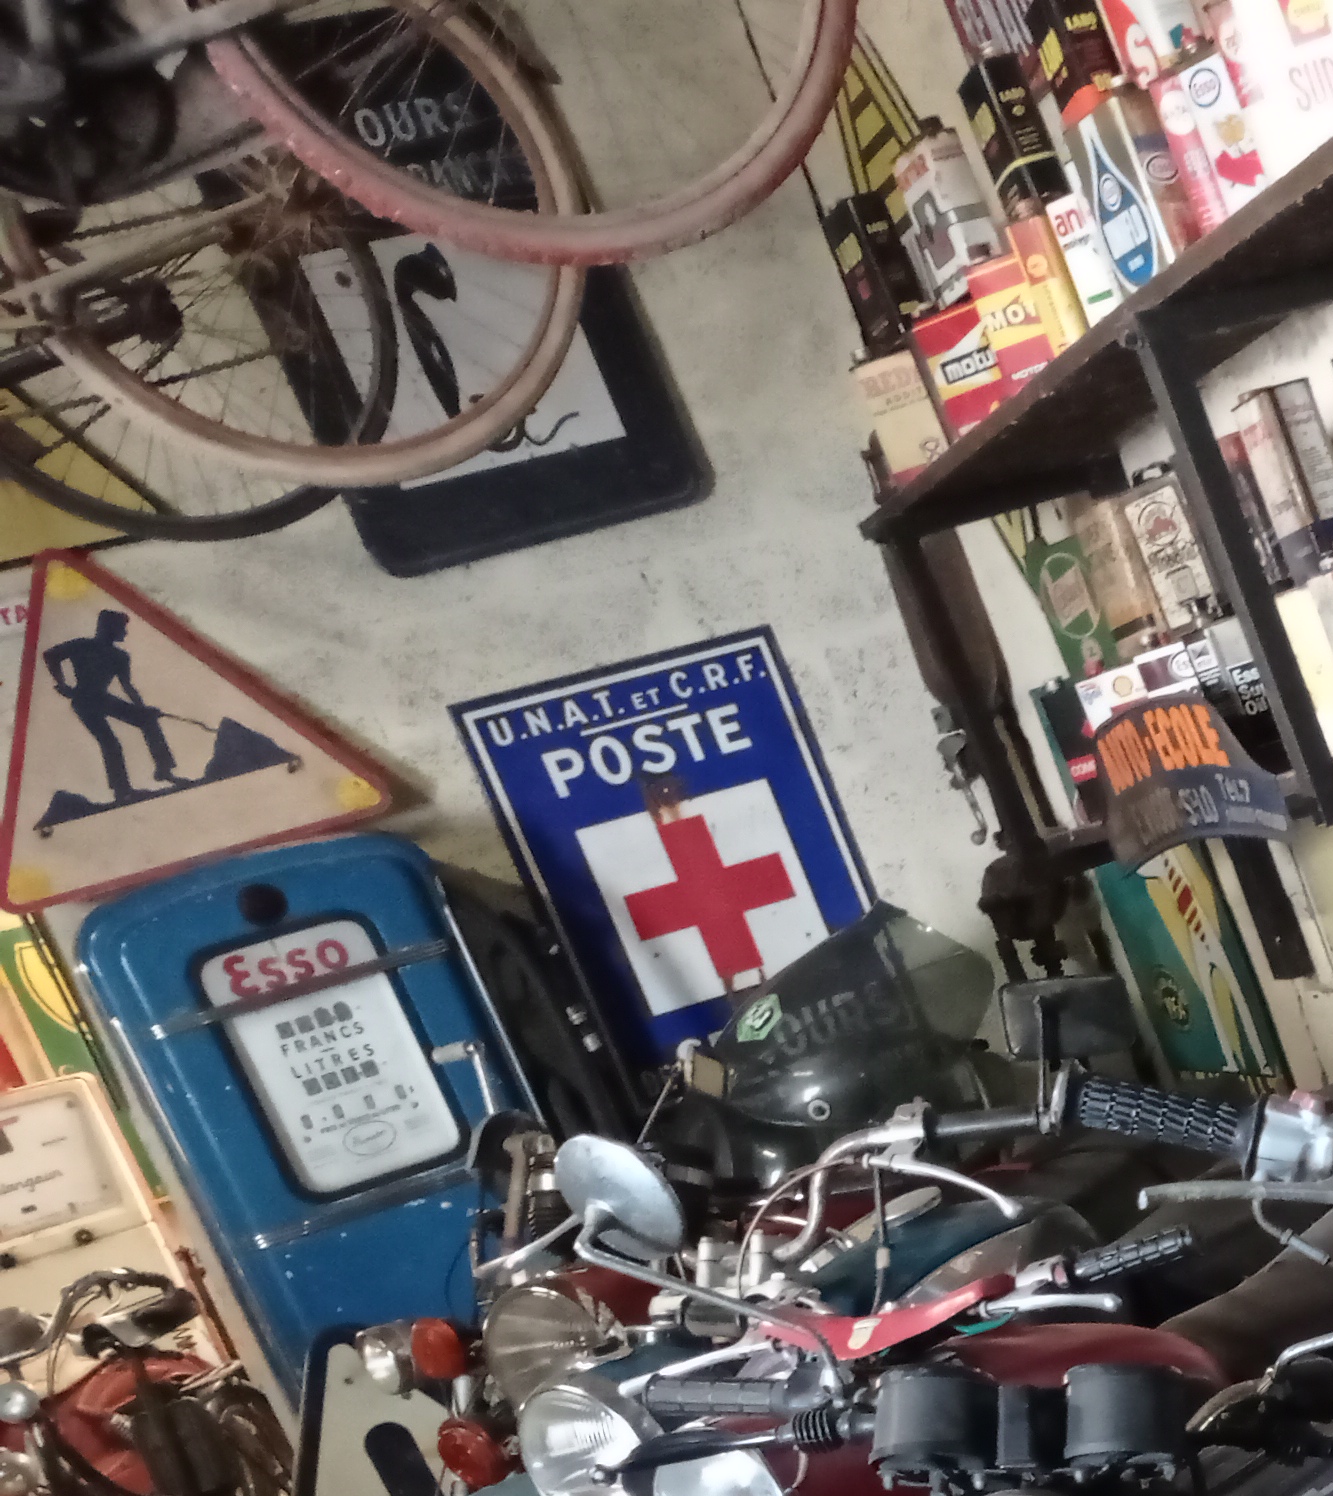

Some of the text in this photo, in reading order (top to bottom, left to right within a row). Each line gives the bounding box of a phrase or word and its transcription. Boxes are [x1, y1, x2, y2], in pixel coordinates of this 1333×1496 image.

[487, 653, 768, 748] U.N.A.T. ET C.R.F.
[540, 703, 753, 800] POSTE
[280, 1020, 365, 1058] FRANCS
[290, 1043, 375, 1080] LITRES
